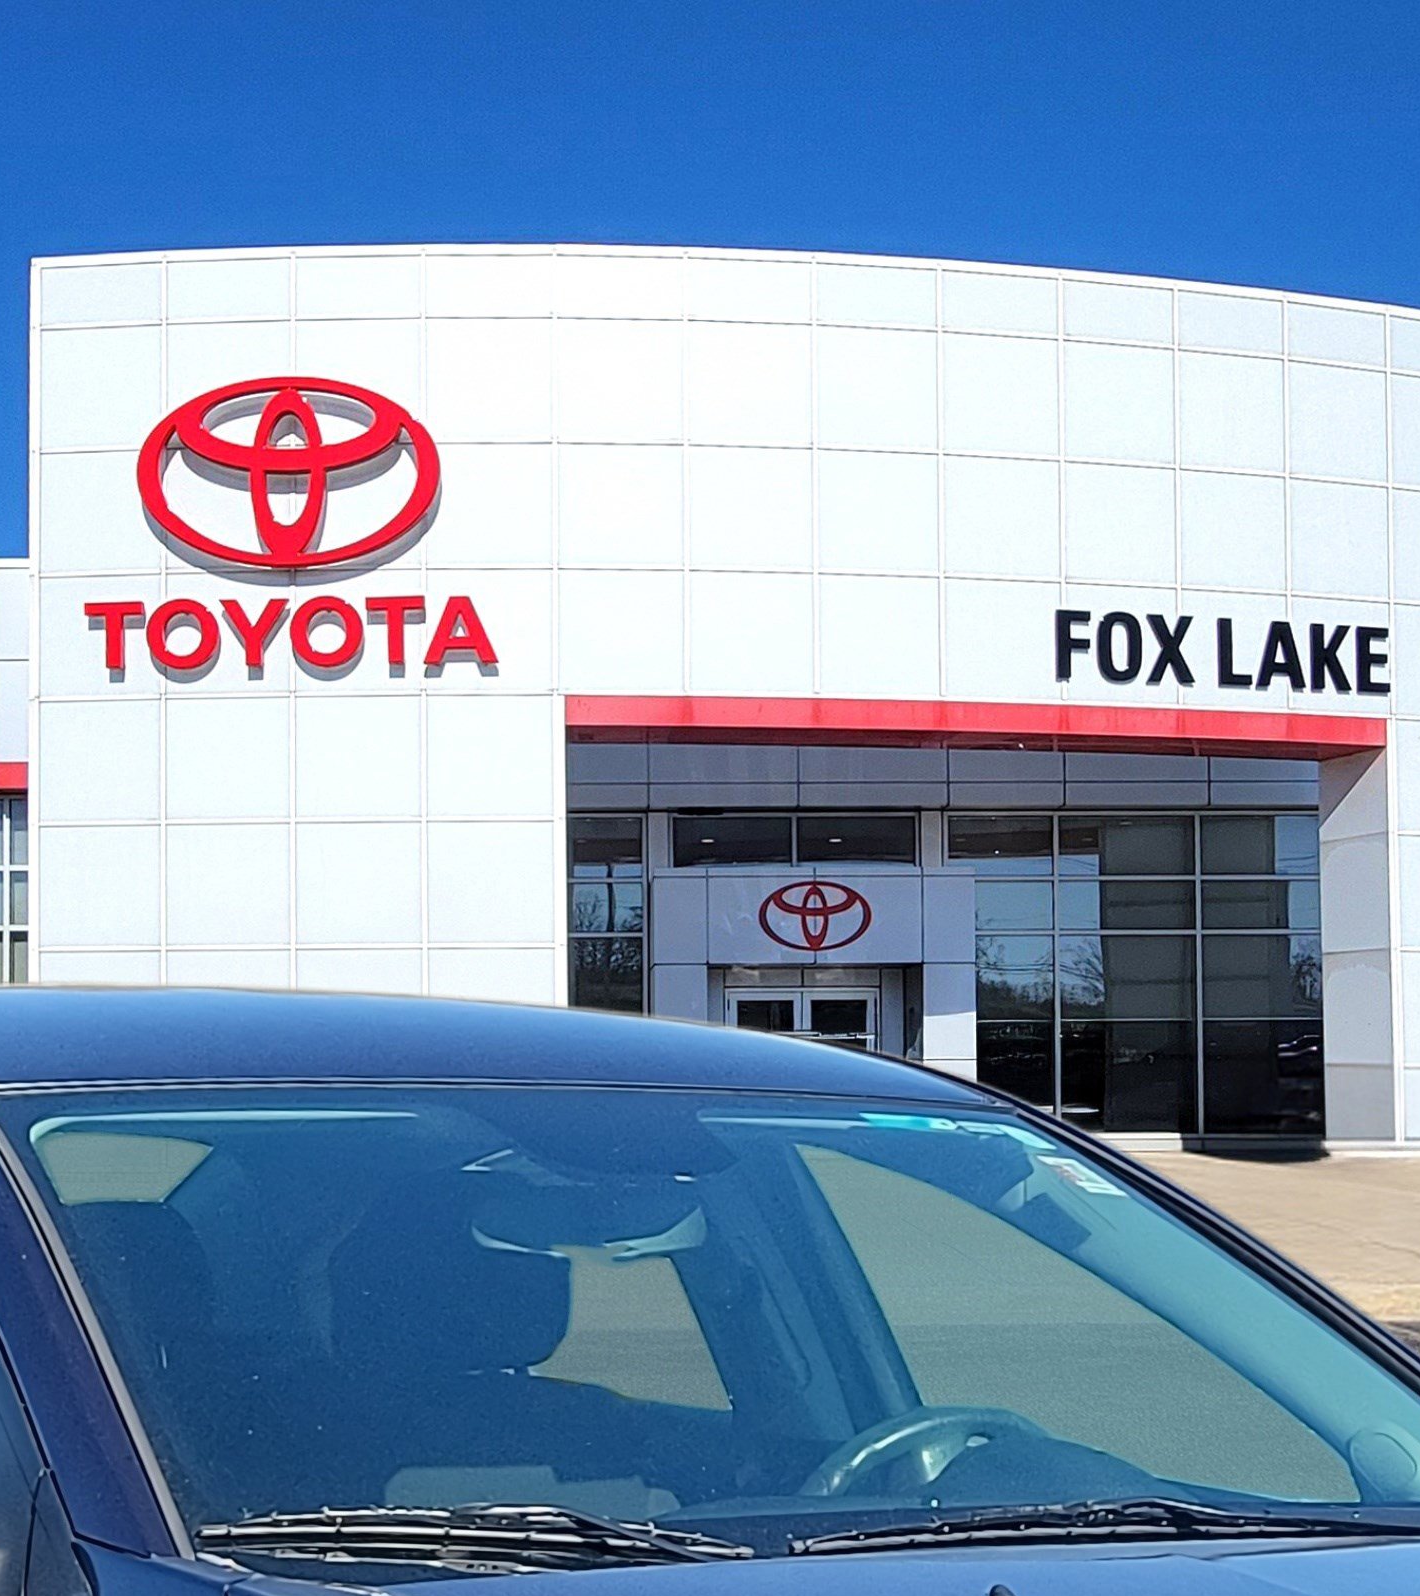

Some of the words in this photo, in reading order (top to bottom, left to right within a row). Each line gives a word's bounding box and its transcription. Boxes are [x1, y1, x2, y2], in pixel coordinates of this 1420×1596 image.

[84, 596, 499, 670] TOYOTA
[1055, 609, 1195, 686] FOX
[1216, 617, 1391, 694] LAKE
